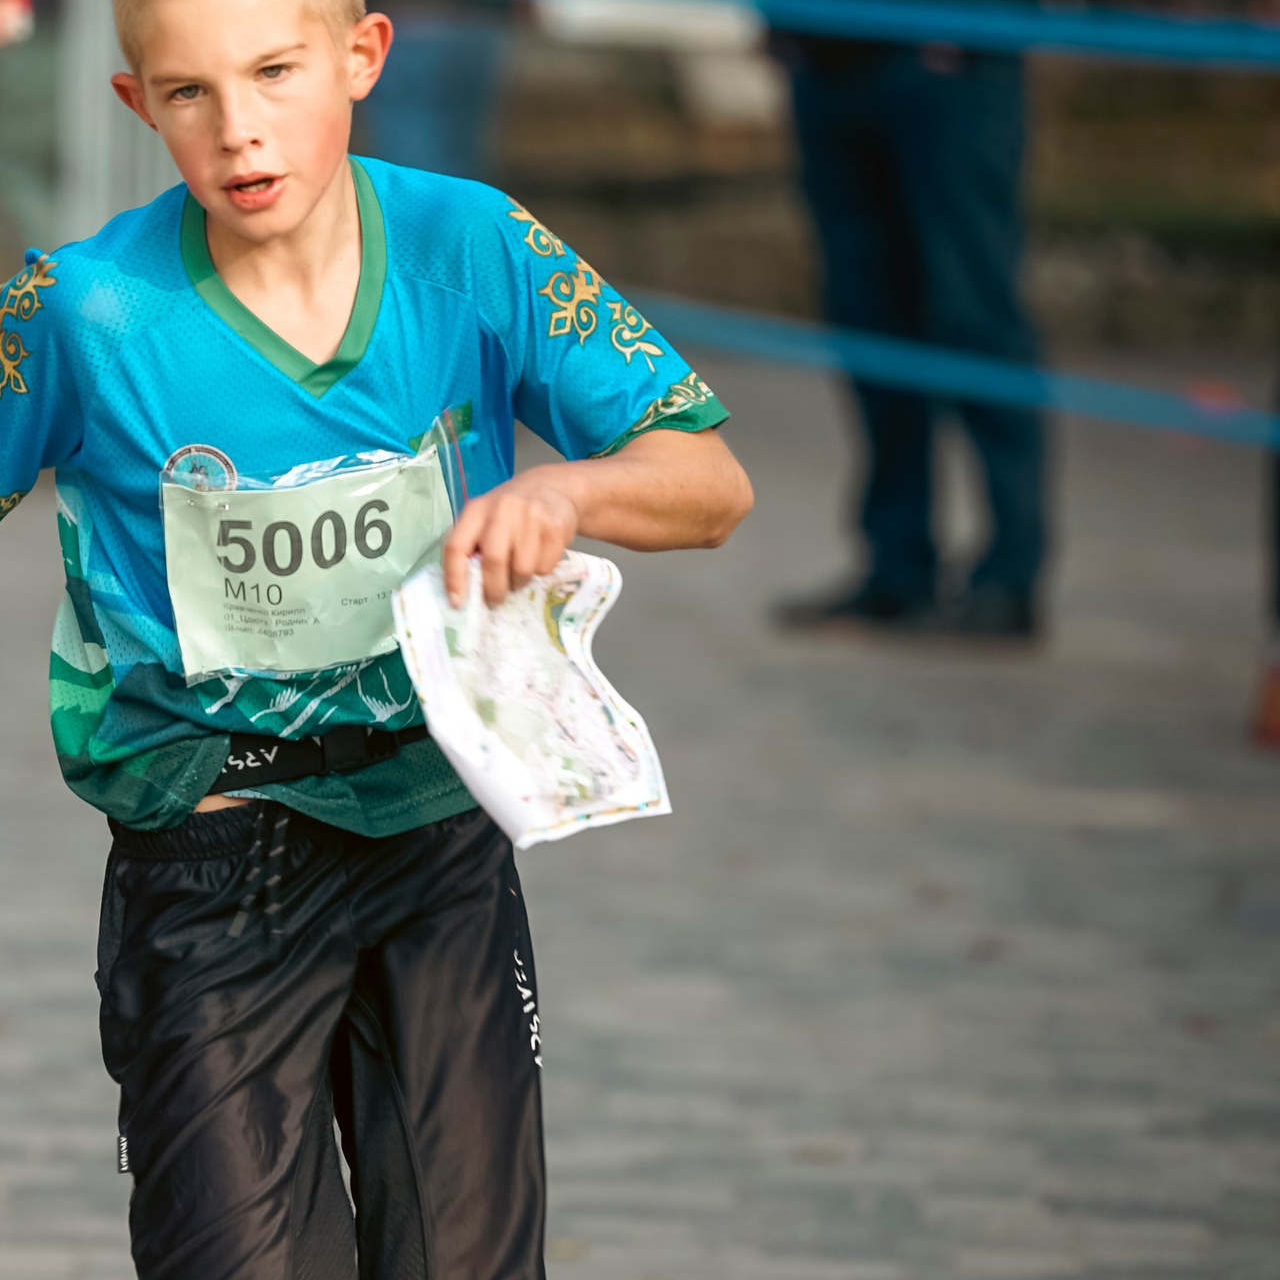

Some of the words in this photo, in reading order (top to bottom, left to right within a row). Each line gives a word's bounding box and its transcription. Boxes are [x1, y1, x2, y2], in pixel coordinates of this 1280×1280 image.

[216, 499, 392, 576] 5006
[340, 597, 368, 606] Старт
[221, 745, 279, 774] ARS
